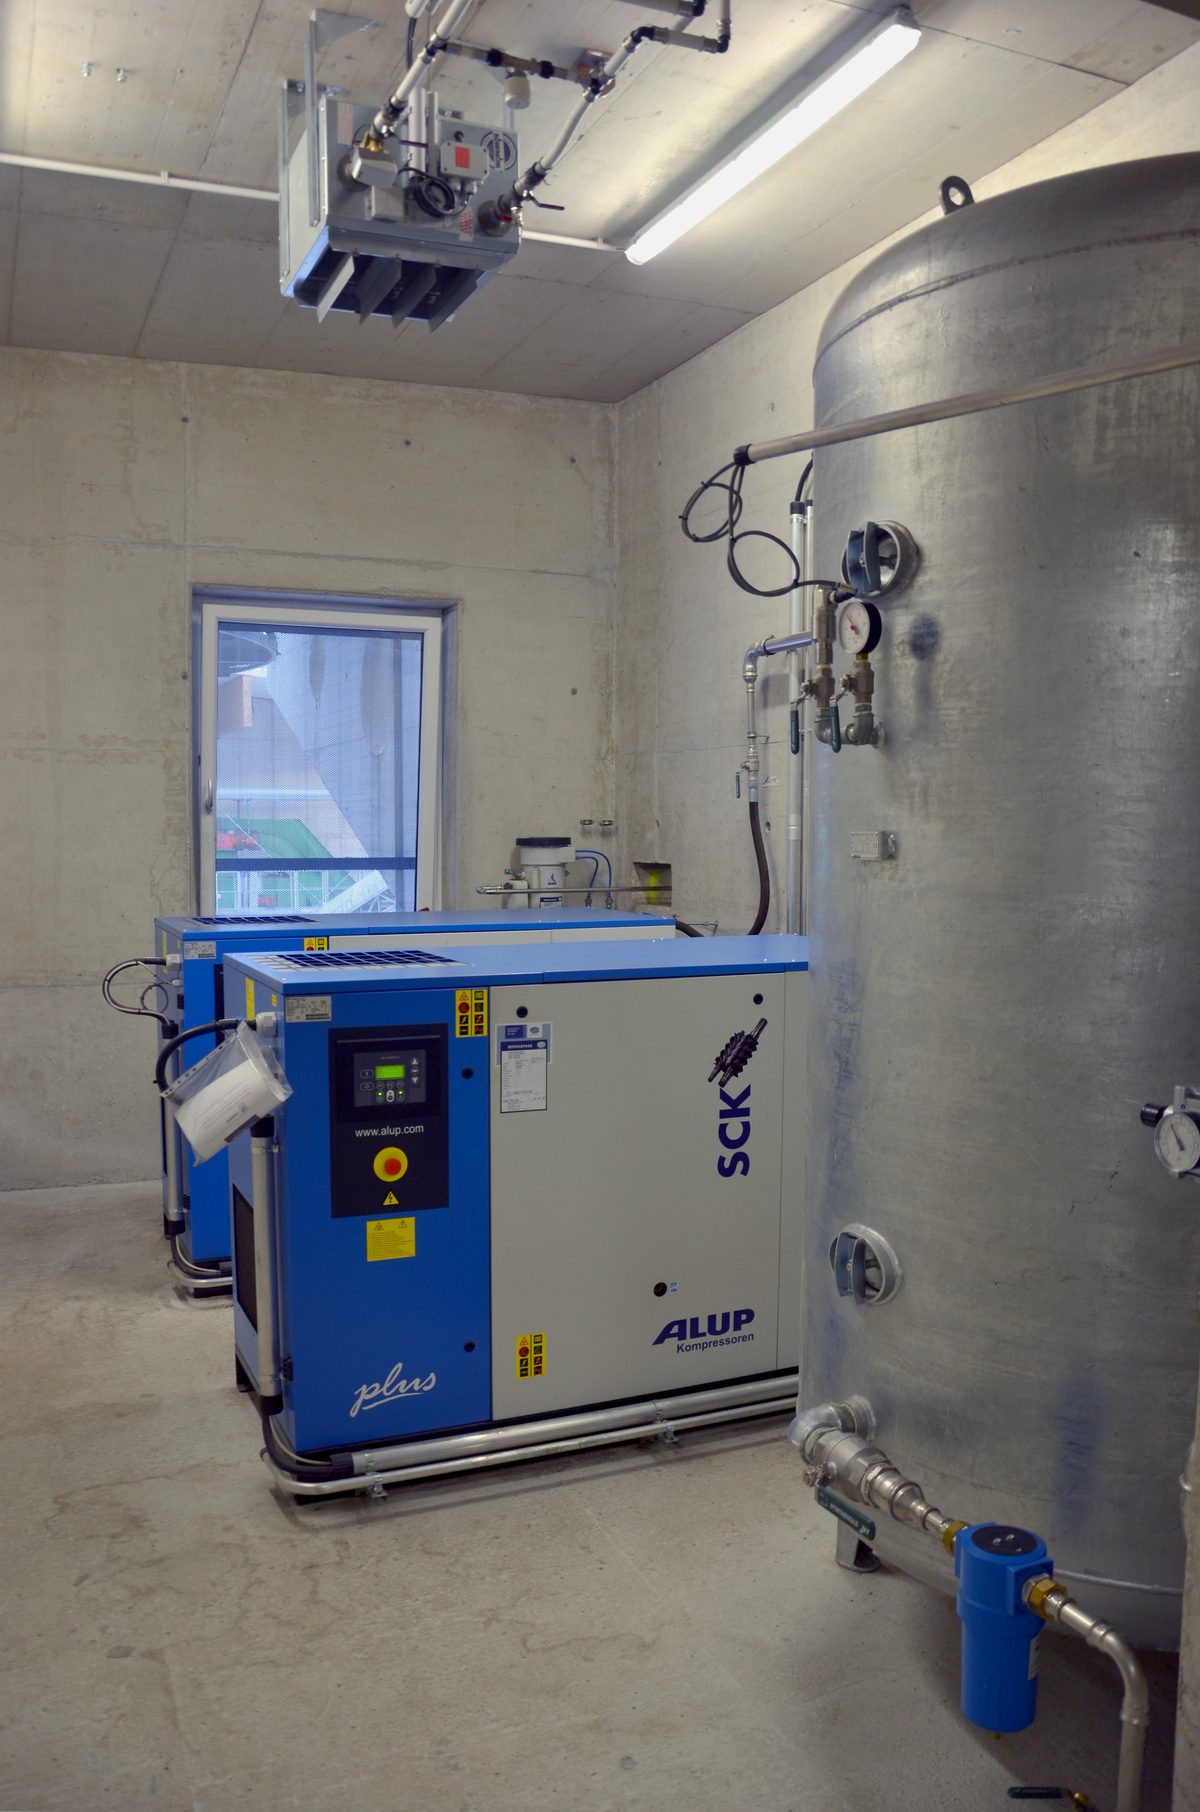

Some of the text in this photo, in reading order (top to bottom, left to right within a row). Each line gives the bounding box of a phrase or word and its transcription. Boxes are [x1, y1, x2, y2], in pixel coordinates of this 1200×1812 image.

[354, 1125, 424, 1137] www.alup.com
[717, 1083, 751, 1178] SCK
[651, 1308, 755, 1345] ALUP
[676, 1333, 754, 1353] Kompressoren
[350, 1362, 436, 1417] plus
